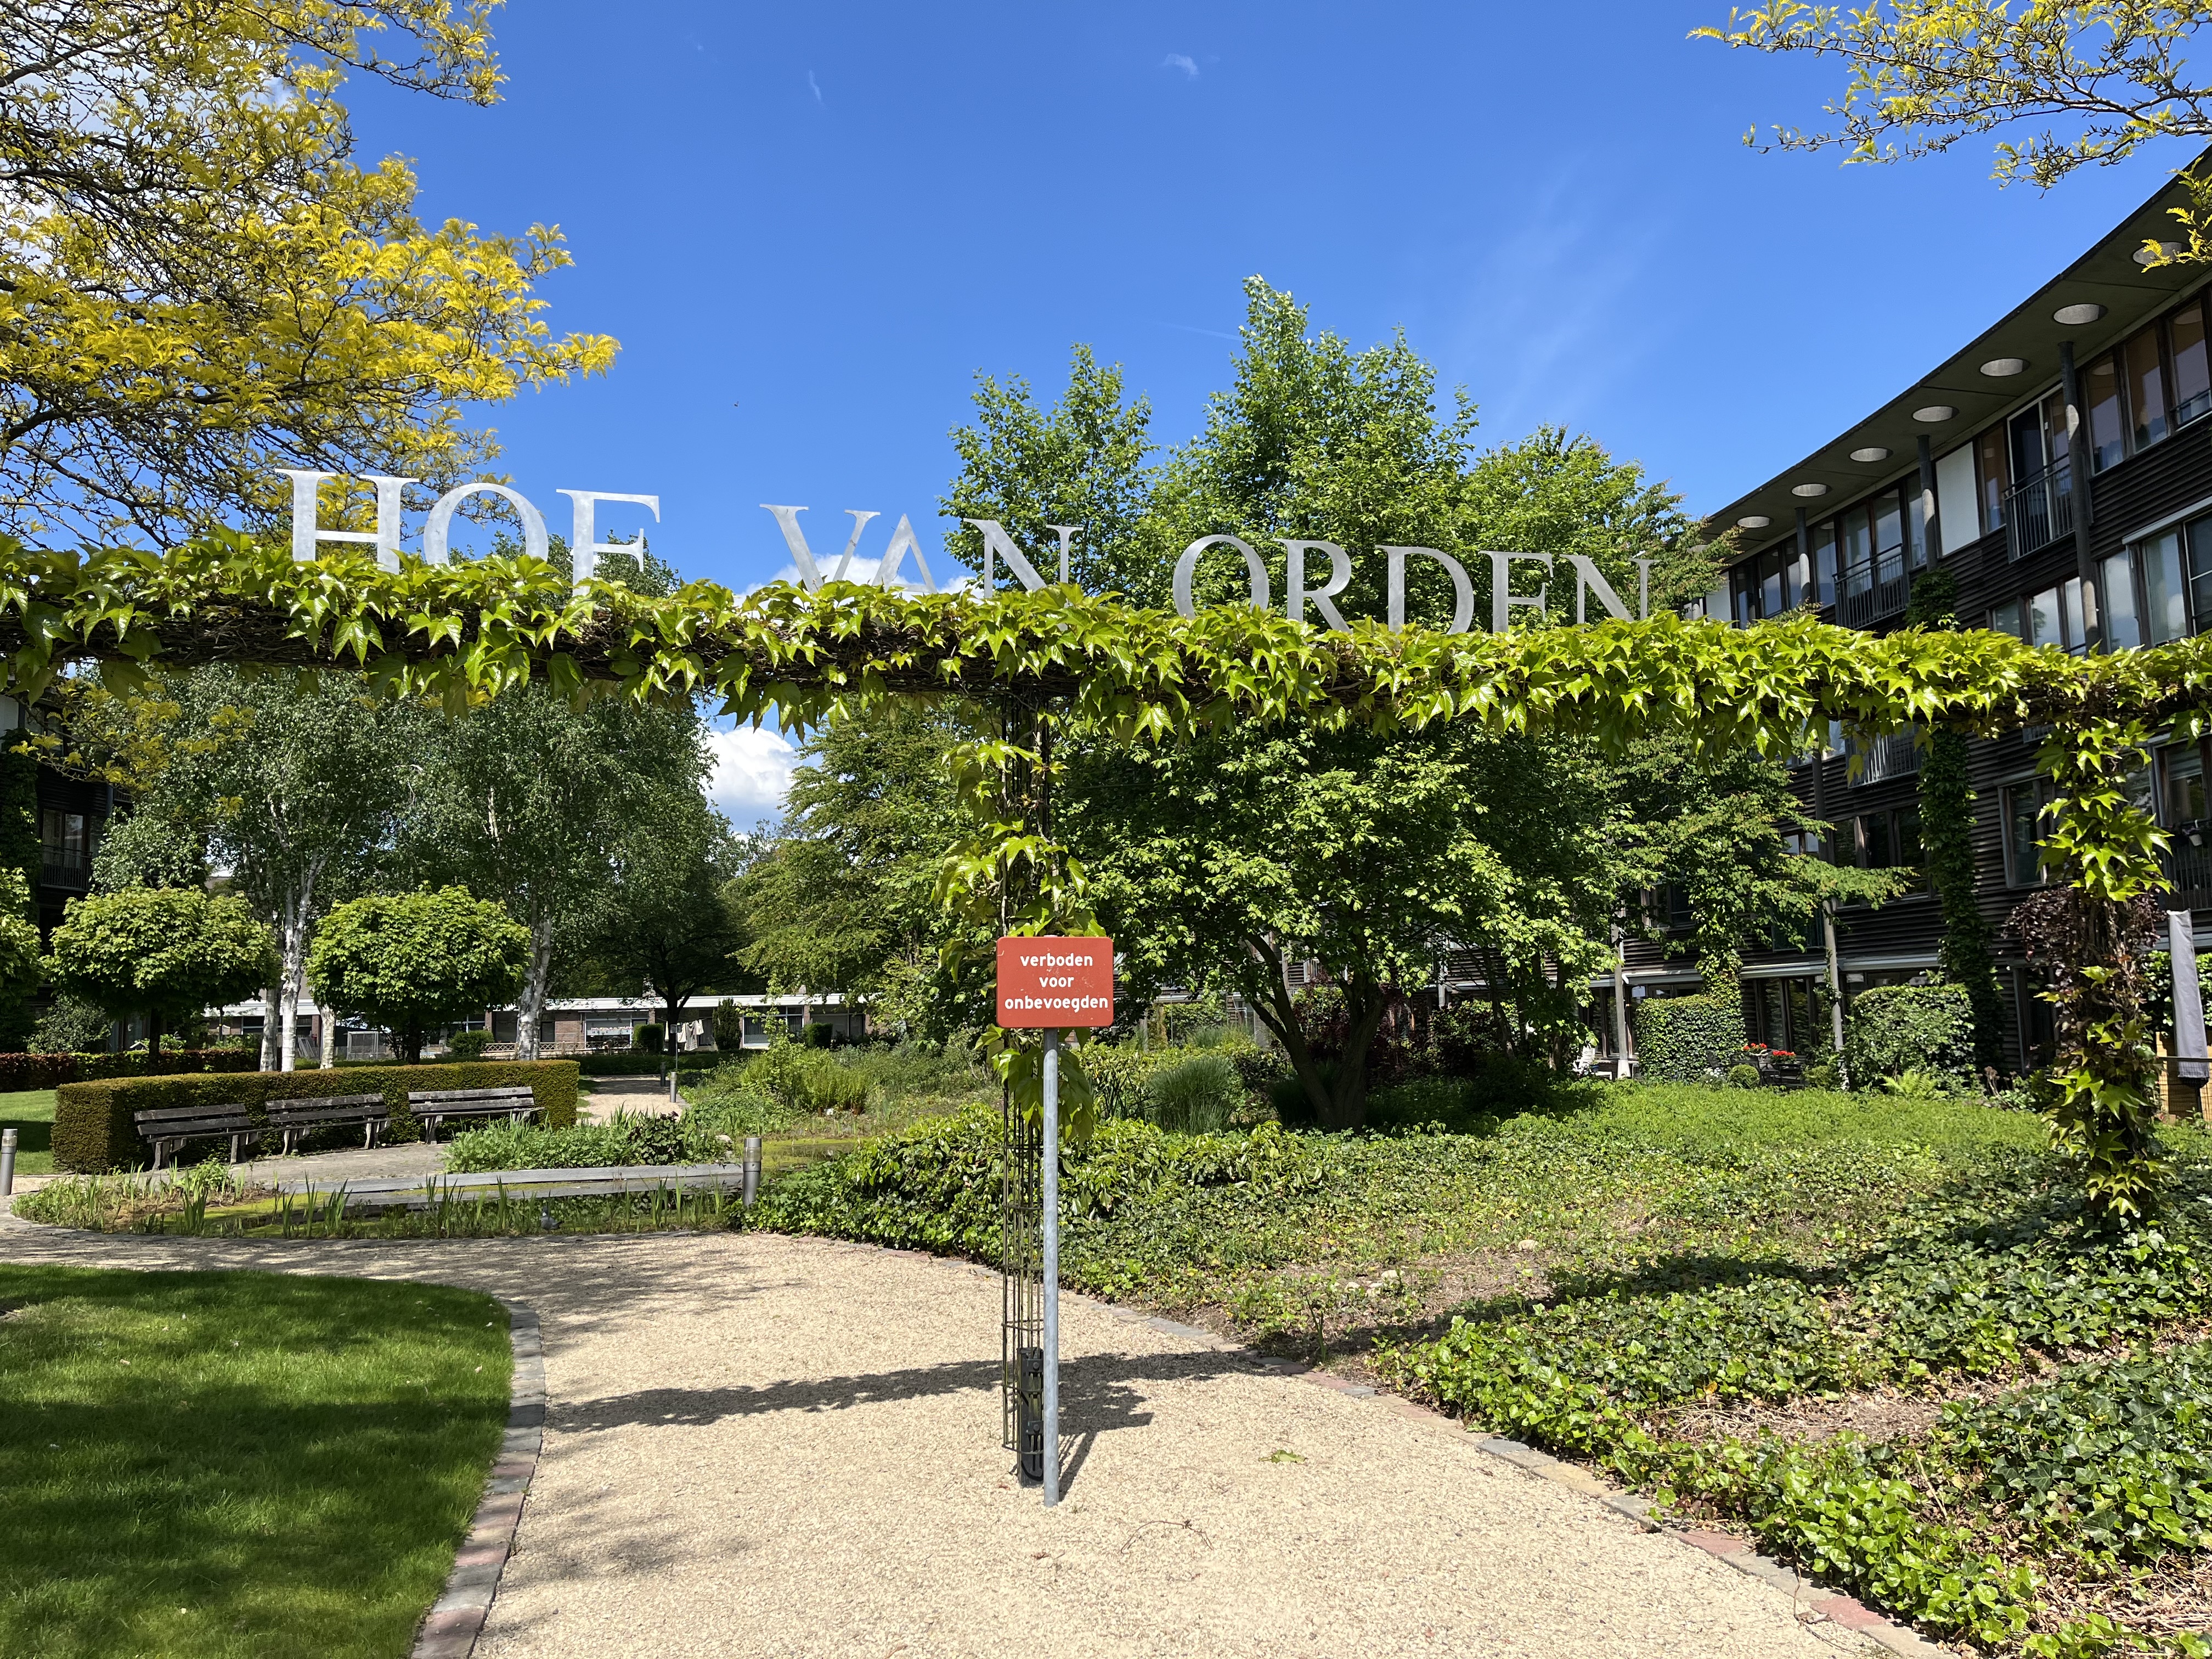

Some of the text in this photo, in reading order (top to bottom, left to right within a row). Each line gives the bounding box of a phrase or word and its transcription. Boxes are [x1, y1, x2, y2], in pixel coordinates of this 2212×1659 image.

[275, 468, 1660, 634] HOF VAN ORDEN
[1020, 952, 1093, 967] verboden
[1039, 977, 1074, 988] voor
[1005, 995, 1108, 1013] onbevoegden
